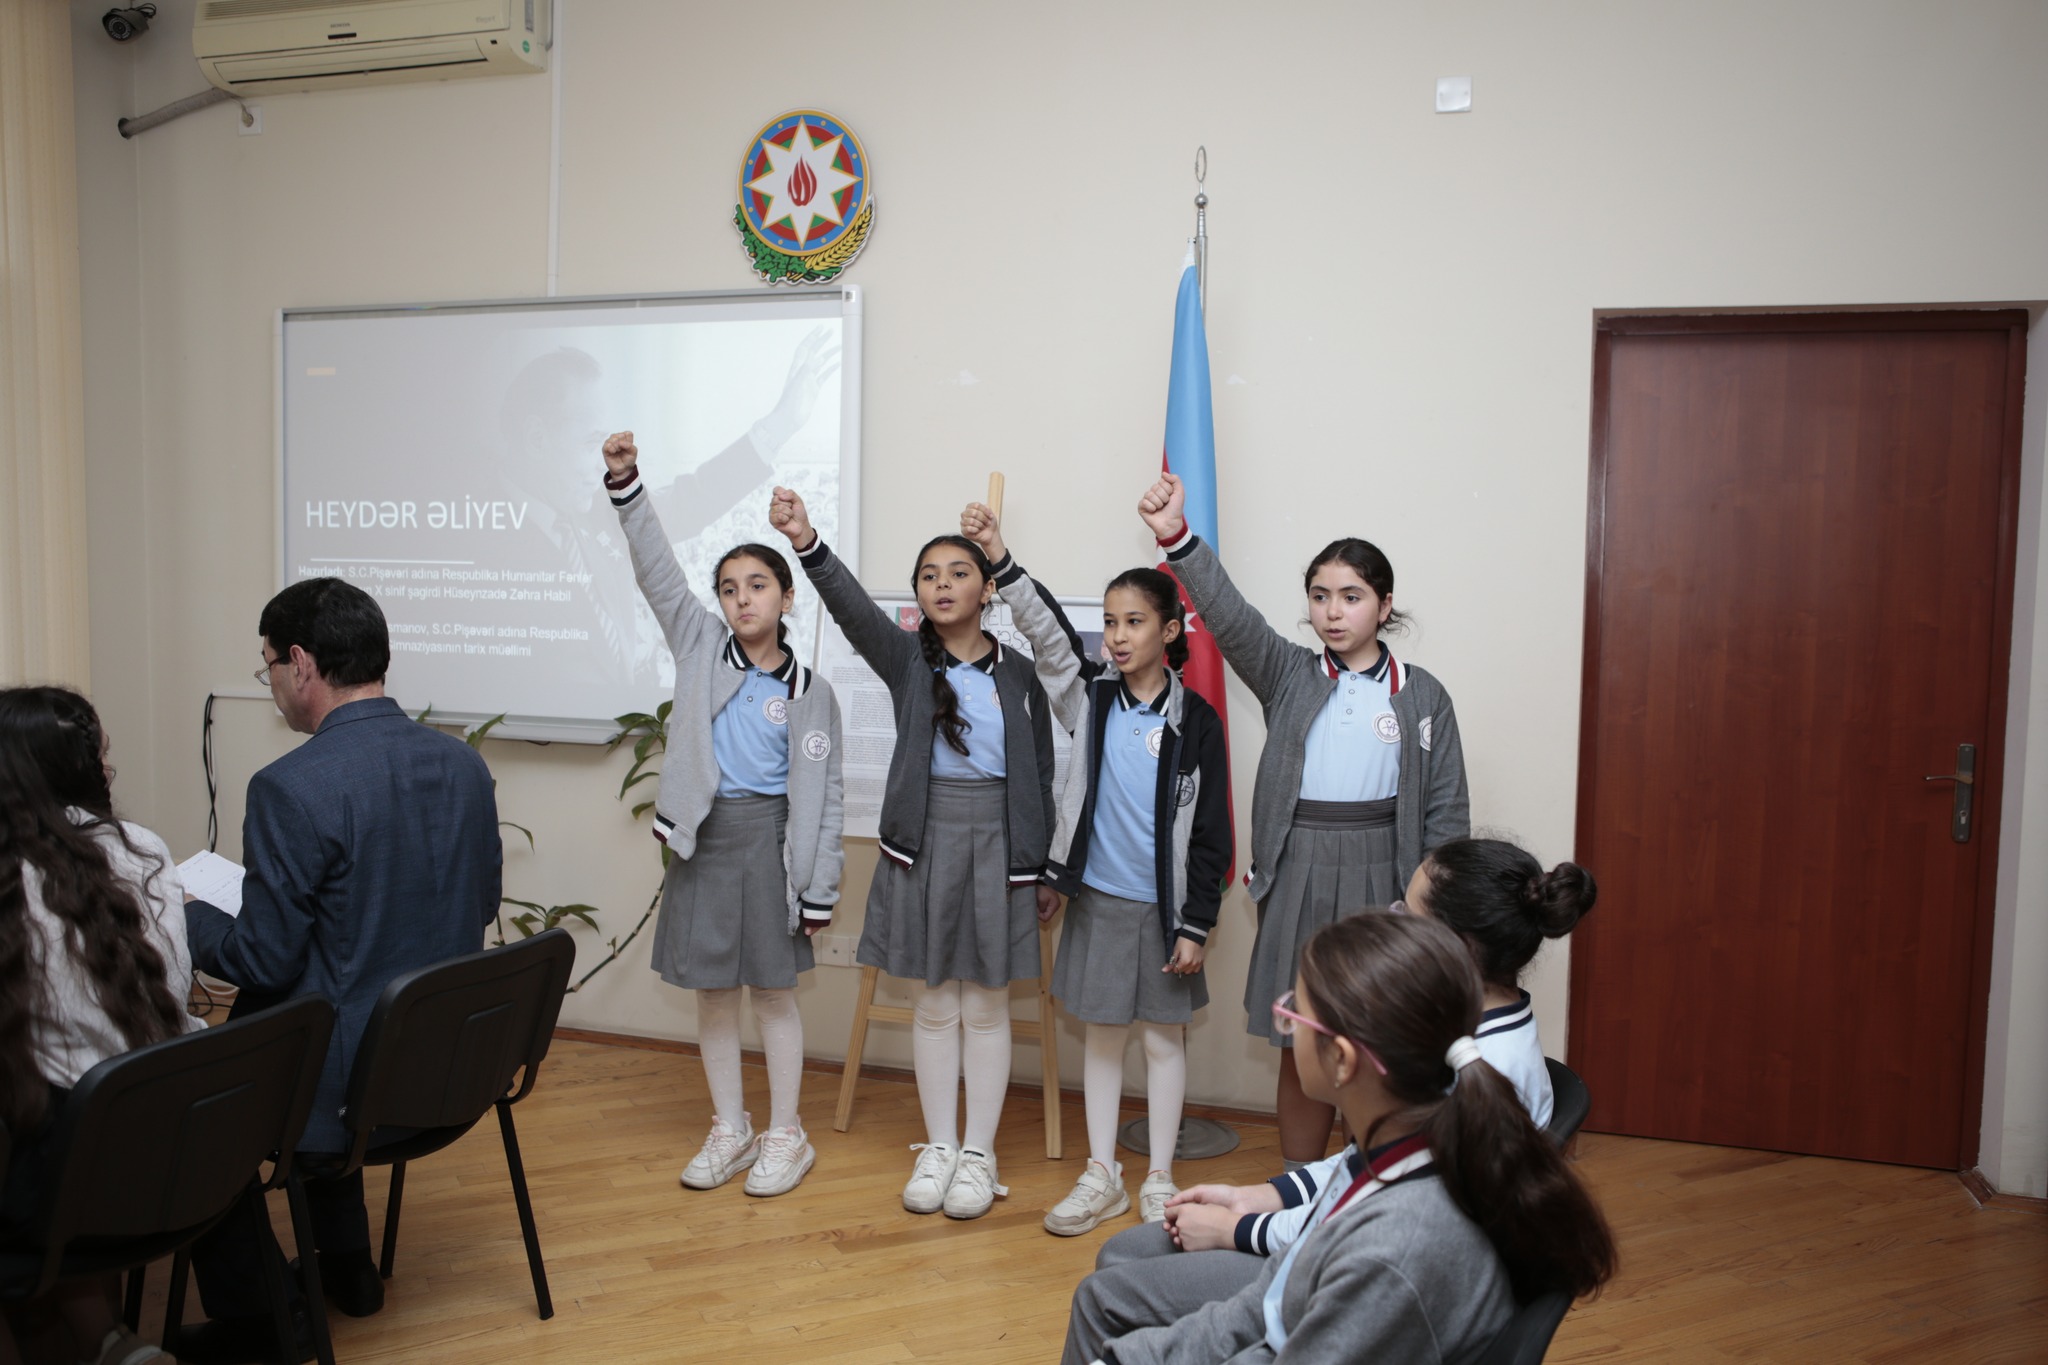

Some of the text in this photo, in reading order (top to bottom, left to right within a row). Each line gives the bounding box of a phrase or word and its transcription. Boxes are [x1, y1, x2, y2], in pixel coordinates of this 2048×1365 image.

[306, 494, 528, 530] HEYDƏR ƏLİYEV
[411, 568, 440, 580] adına
[442, 568, 499, 583] Respublika
[501, 569, 556, 583] Humanitar
[374, 585, 383, 597] X
[385, 586, 405, 598] sinif
[408, 586, 441, 600] şagirdi
[443, 587, 508, 602] Hüseynzadə
[510, 589, 541, 601] Zəhra
[544, 590, 571, 601] Habil
[388, 623, 430, 636] smanov,
[497, 626, 527, 638] adına
[529, 626, 589, 642] Respublika
[464, 643, 486, 655] tarix
[488, 643, 532, 656] müəllimi
